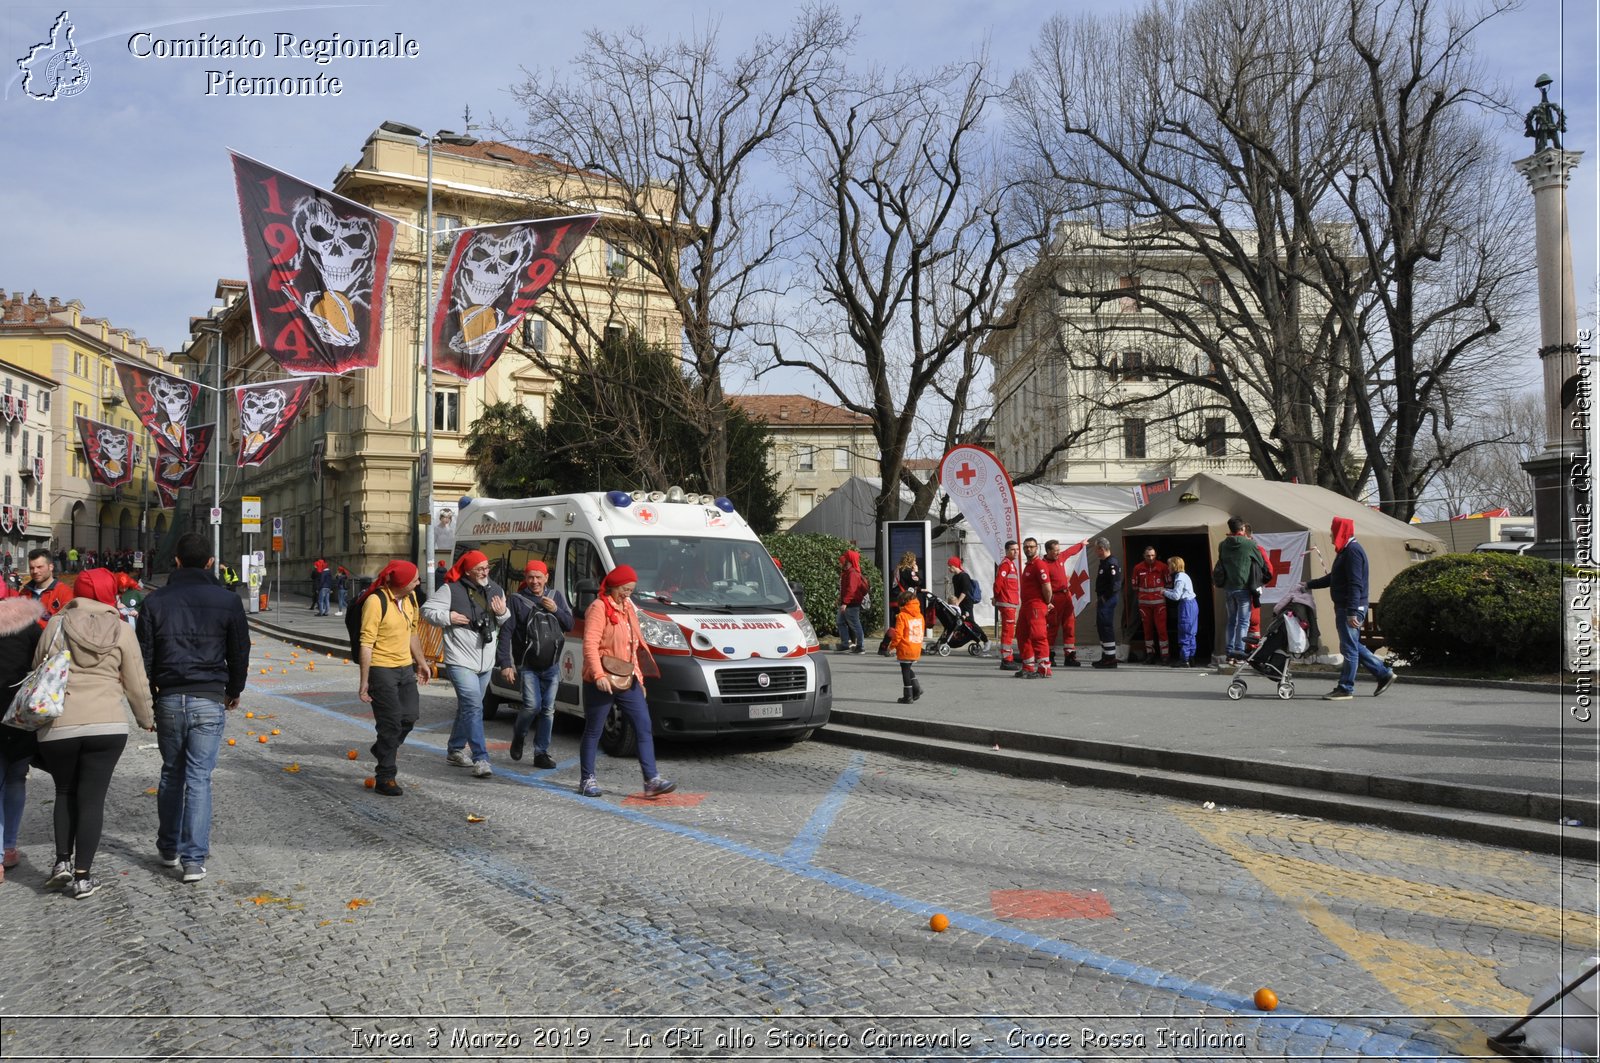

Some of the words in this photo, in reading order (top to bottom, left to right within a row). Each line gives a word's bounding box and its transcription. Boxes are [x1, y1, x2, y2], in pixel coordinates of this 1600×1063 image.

[259, 176, 314, 361] 1954
[473, 523, 491, 535] CROCE
[492, 521, 511, 533] ROSSA
[512, 520, 543, 532] ITALIANA
[995, 474, 1009, 503] Croce
[1004, 507, 1013, 539] Rossa
